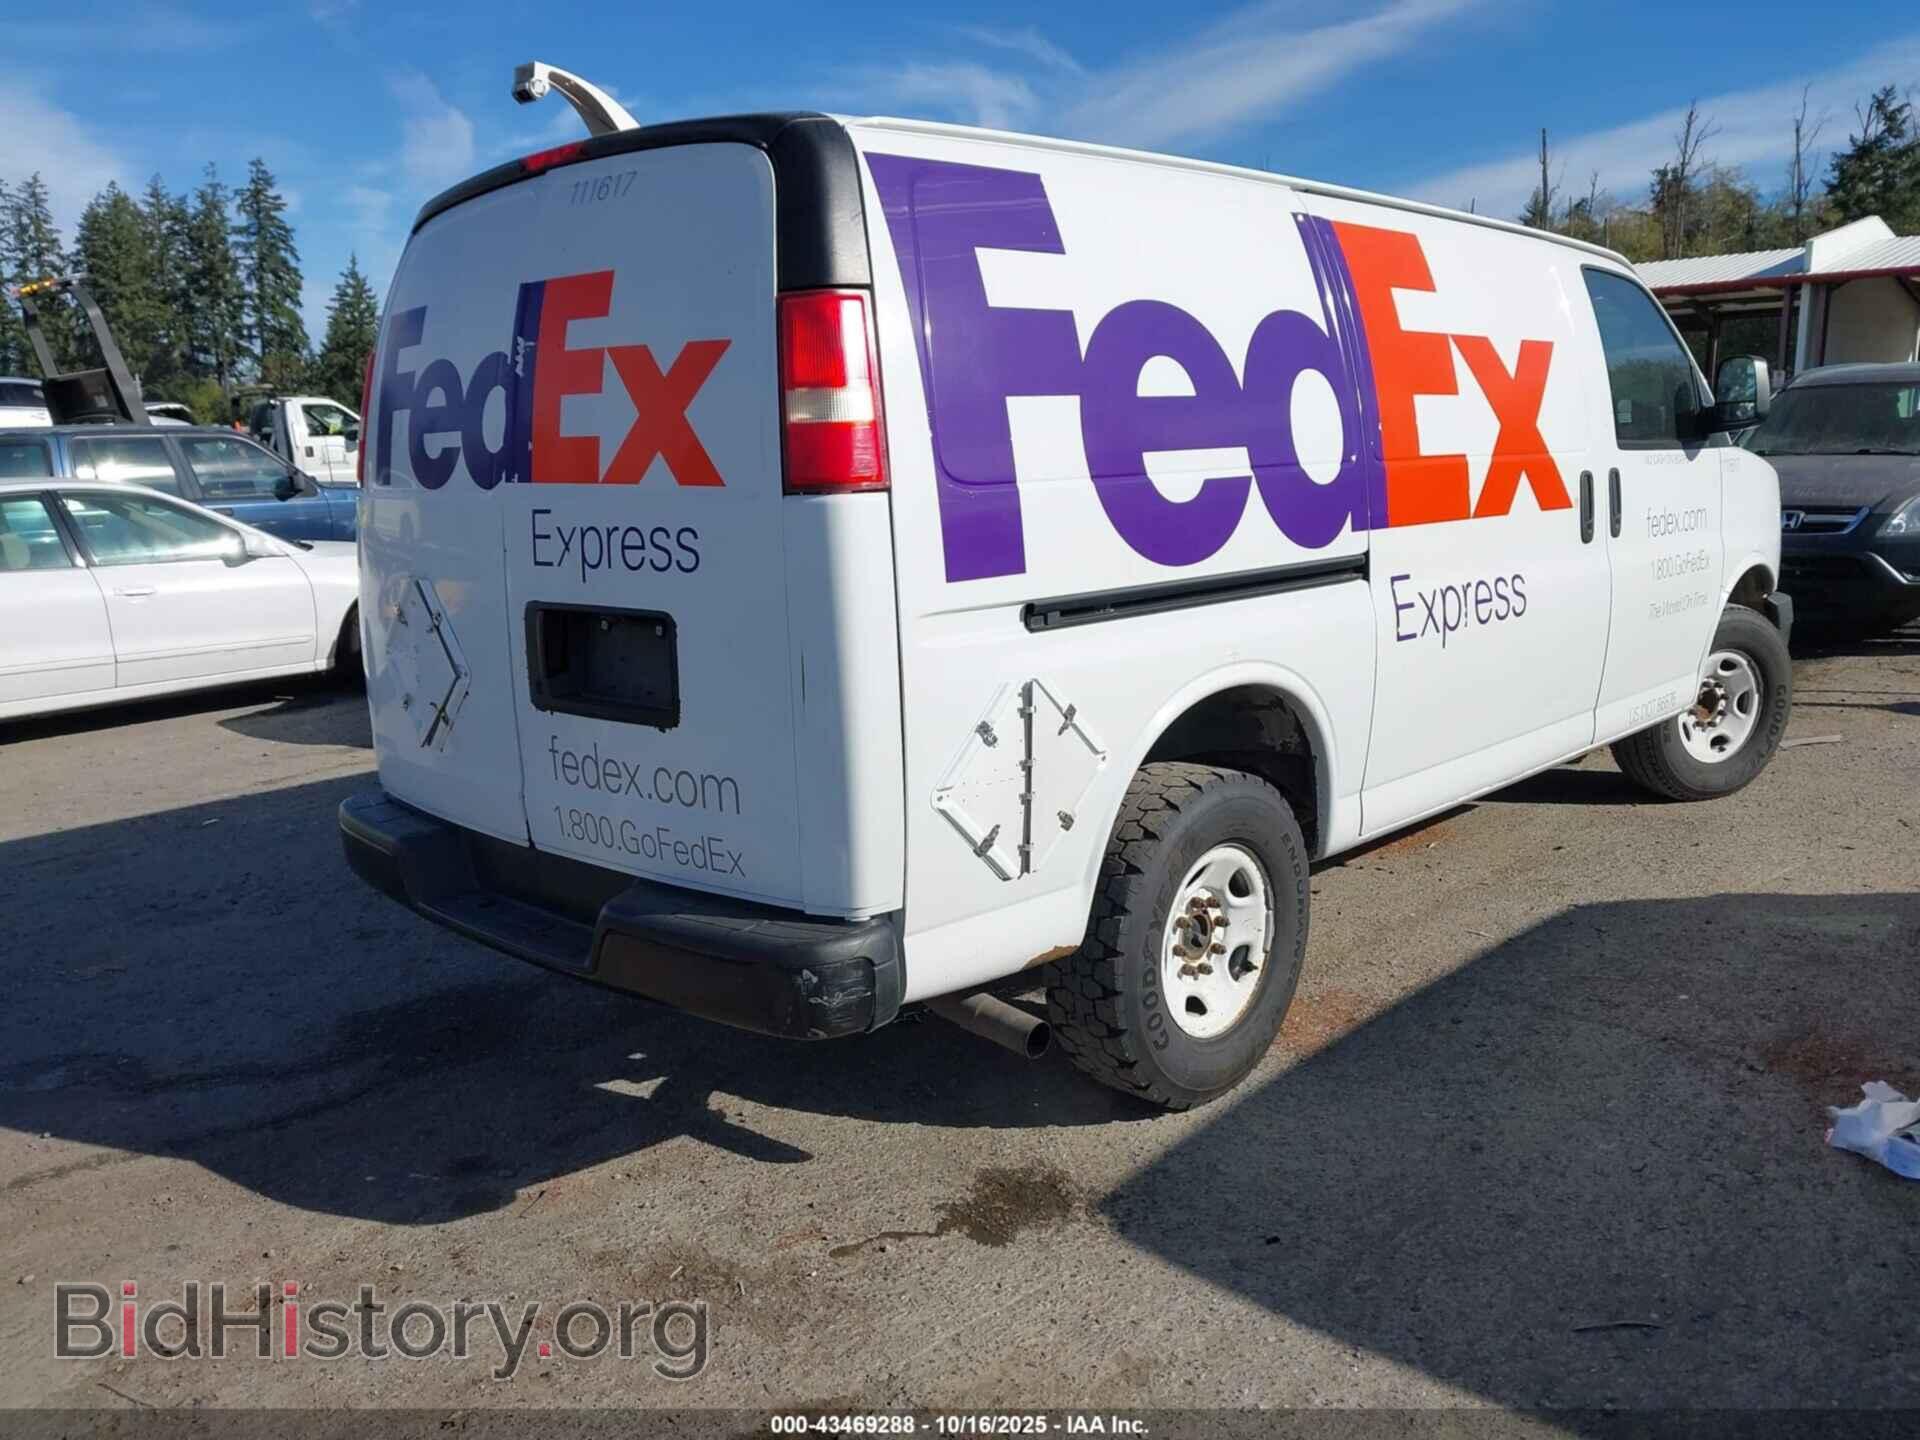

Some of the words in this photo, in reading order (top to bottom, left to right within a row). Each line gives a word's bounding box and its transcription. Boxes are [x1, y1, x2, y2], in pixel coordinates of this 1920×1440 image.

[570, 171, 638, 205] 111617
[376, 270, 732, 490] FedEx
[862, 151, 1574, 584] FedEx
[531, 508, 701, 583] Express
[1646, 507, 1709, 538] fedex.com
[1390, 572, 1528, 648] Express
[548, 735, 741, 814] fedex.com
[554, 804, 746, 878] 1.800.GoFedEx
